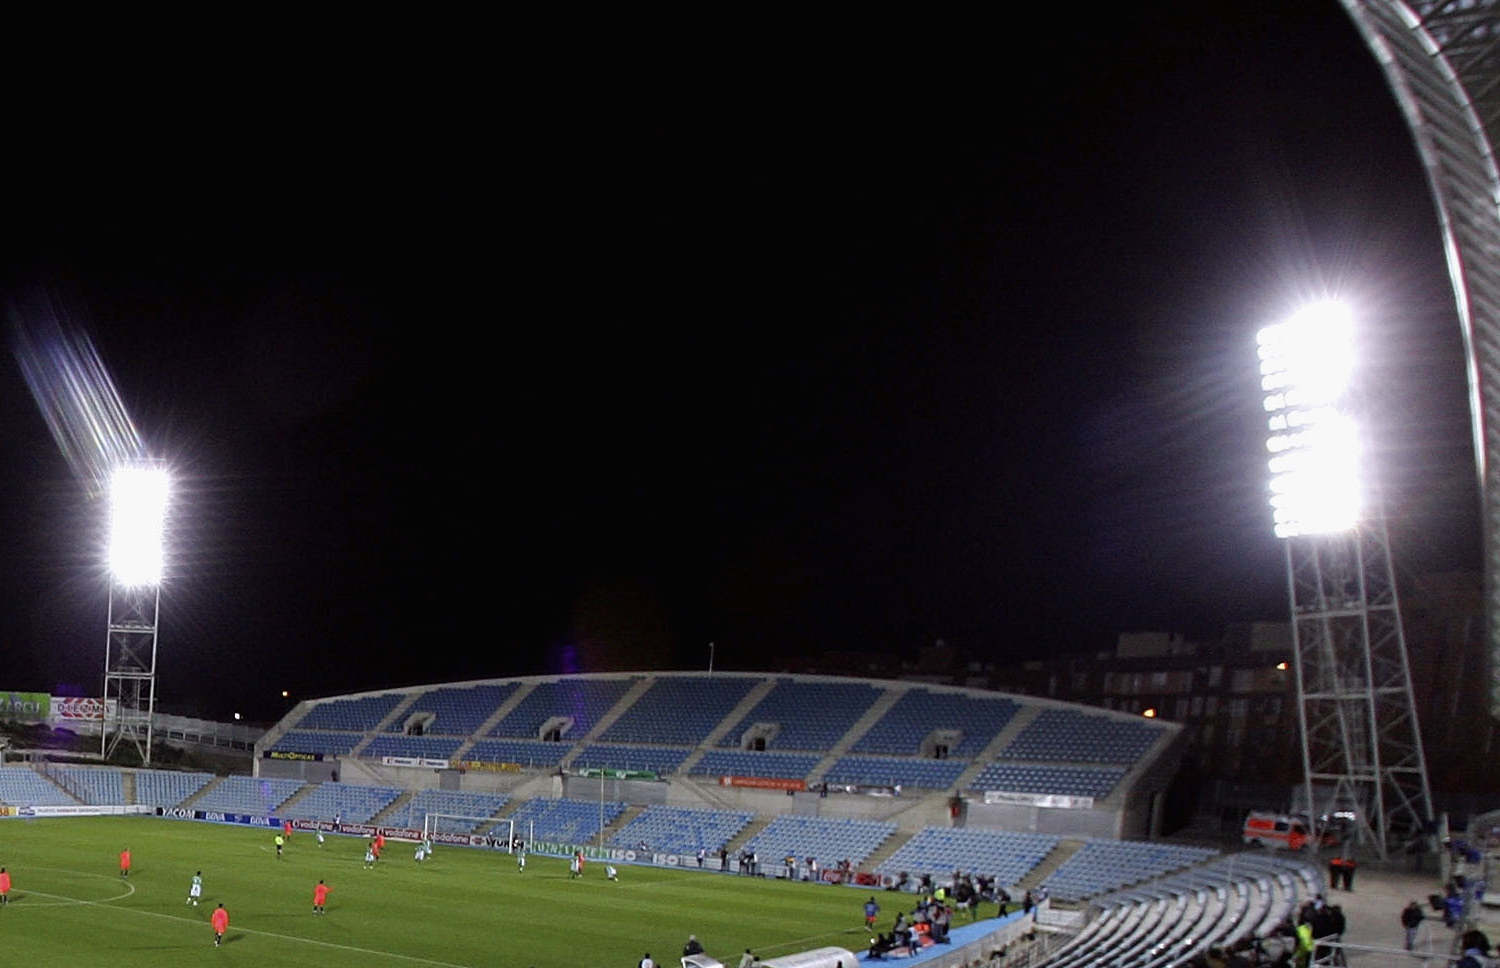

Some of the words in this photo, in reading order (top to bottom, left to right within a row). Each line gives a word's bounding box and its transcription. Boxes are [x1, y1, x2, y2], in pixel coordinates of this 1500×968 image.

[342, 824, 376, 836] vodafone
[384, 827, 419, 839] vodafone
[609, 849, 637, 861] ISO
[652, 853, 679, 866] ISO
